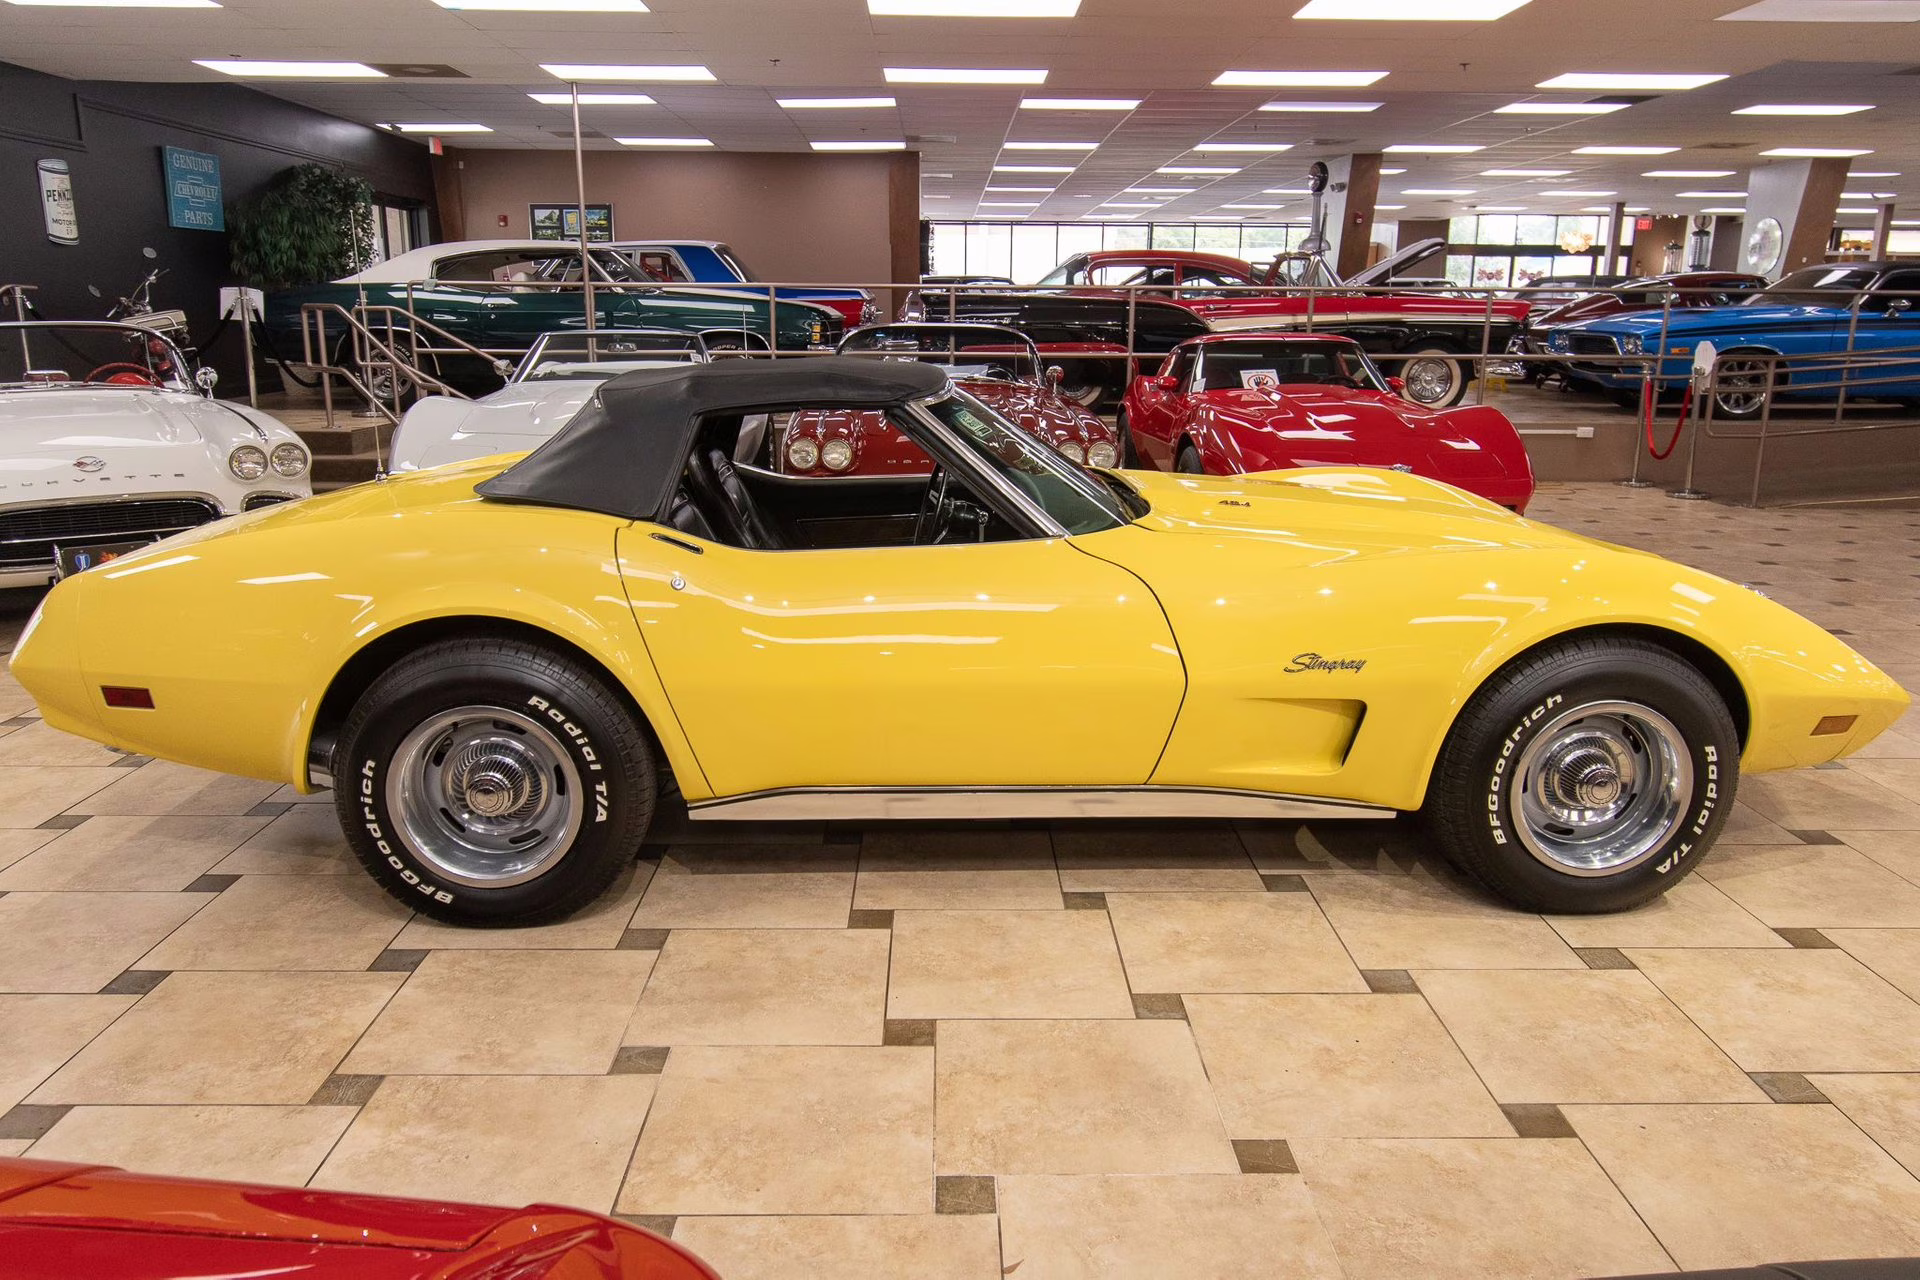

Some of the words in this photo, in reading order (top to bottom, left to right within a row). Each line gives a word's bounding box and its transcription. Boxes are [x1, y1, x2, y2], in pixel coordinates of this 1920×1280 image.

[172, 153, 215, 173] GENUINE
[46, 188, 72, 202] PENNZ
[177, 183, 216, 199] CHEVROLET
[52, 218, 73, 226] MOTOR
[184, 210, 214, 226] PARTS
[1283, 652, 1367, 674] Stingray
[527, 694, 602, 771] Radial
[594, 780, 609, 823] T/A
[1487, 693, 1563, 845] BFGoodrich
[1692, 745, 1718, 836] Radial
[360, 758, 456, 905] BFGoodrich
[1656, 842, 1692, 875] T/A
